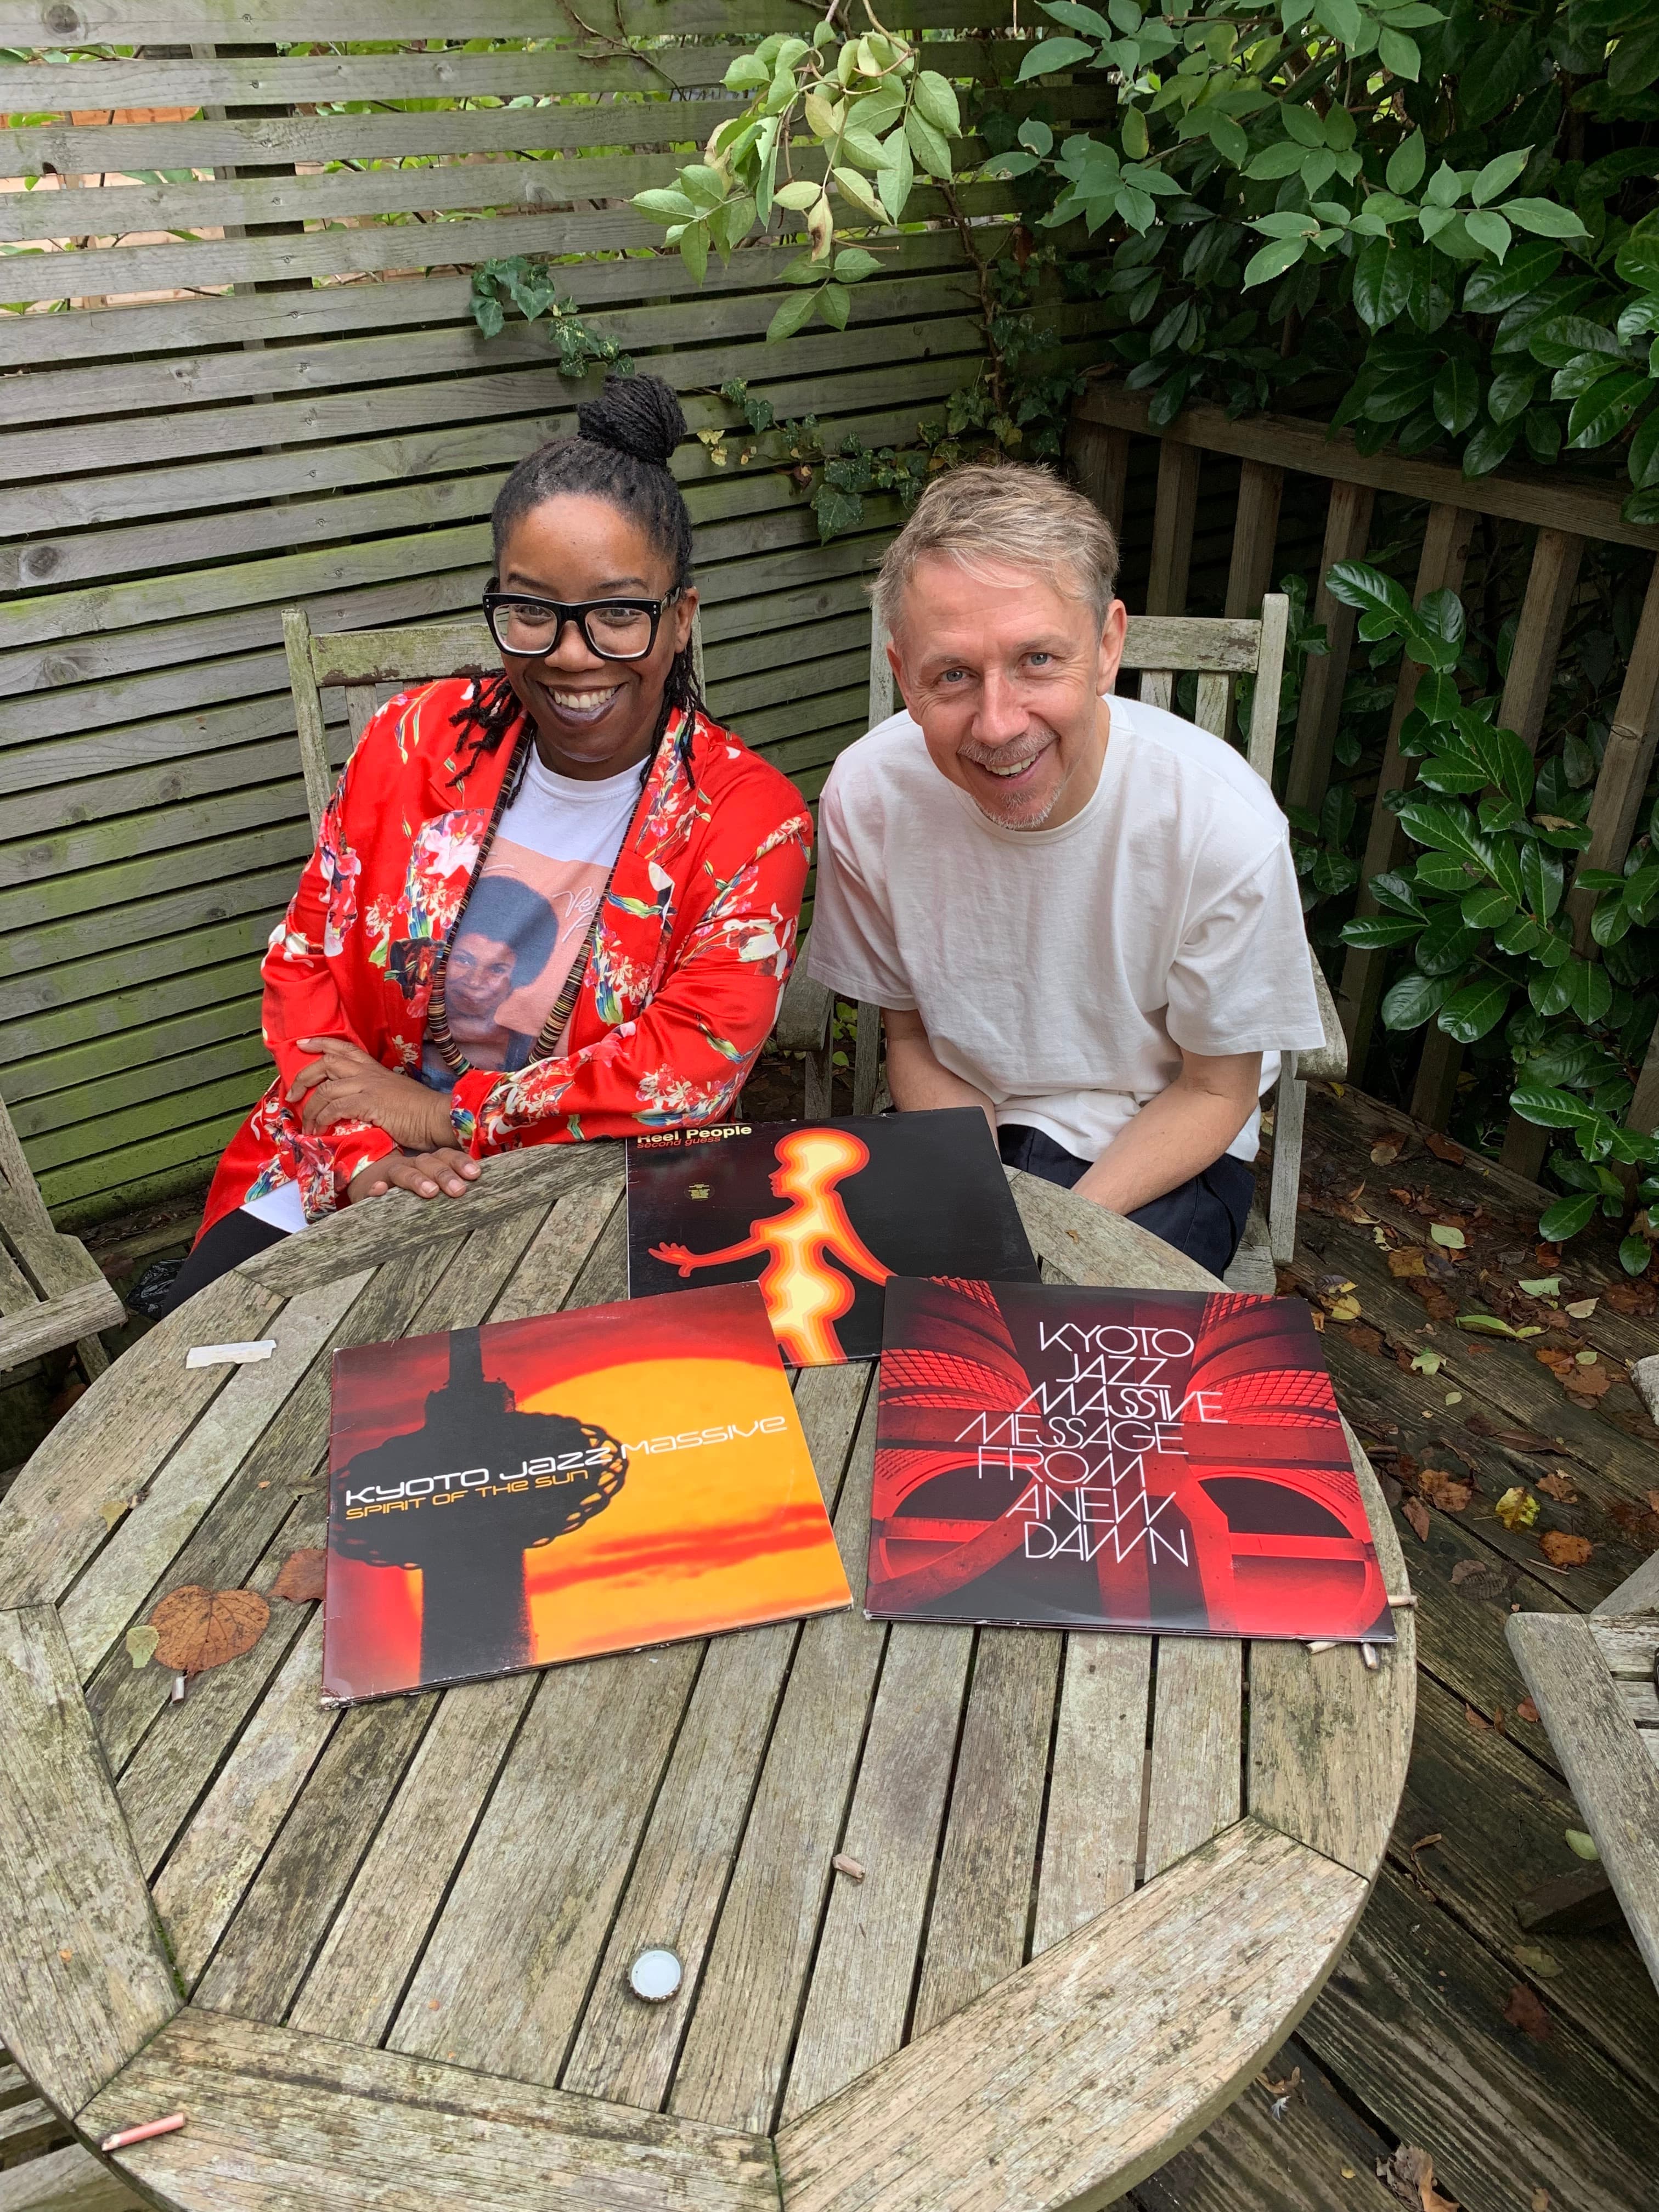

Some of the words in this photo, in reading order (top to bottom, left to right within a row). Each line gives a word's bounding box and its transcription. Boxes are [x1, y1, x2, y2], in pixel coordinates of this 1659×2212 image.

[637, 1131, 679, 1143] Reel
[686, 1125, 752, 1138] People
[637, 1138, 681, 1149] second
[684, 1136, 721, 1147] guess
[1039, 1321, 1195, 1358] KYOTO
[1056, 1353, 1171, 1388] JAZZ
[1015, 1381, 1228, 1424] MASSIVE
[954, 1410, 1189, 1455] MESSAGE
[978, 1445, 1146, 1488] FROM
[345, 1497, 427, 1520] SPIRIT
[432, 1489, 469, 1506] OF
[1024, 1521, 1189, 1567] DAWN
